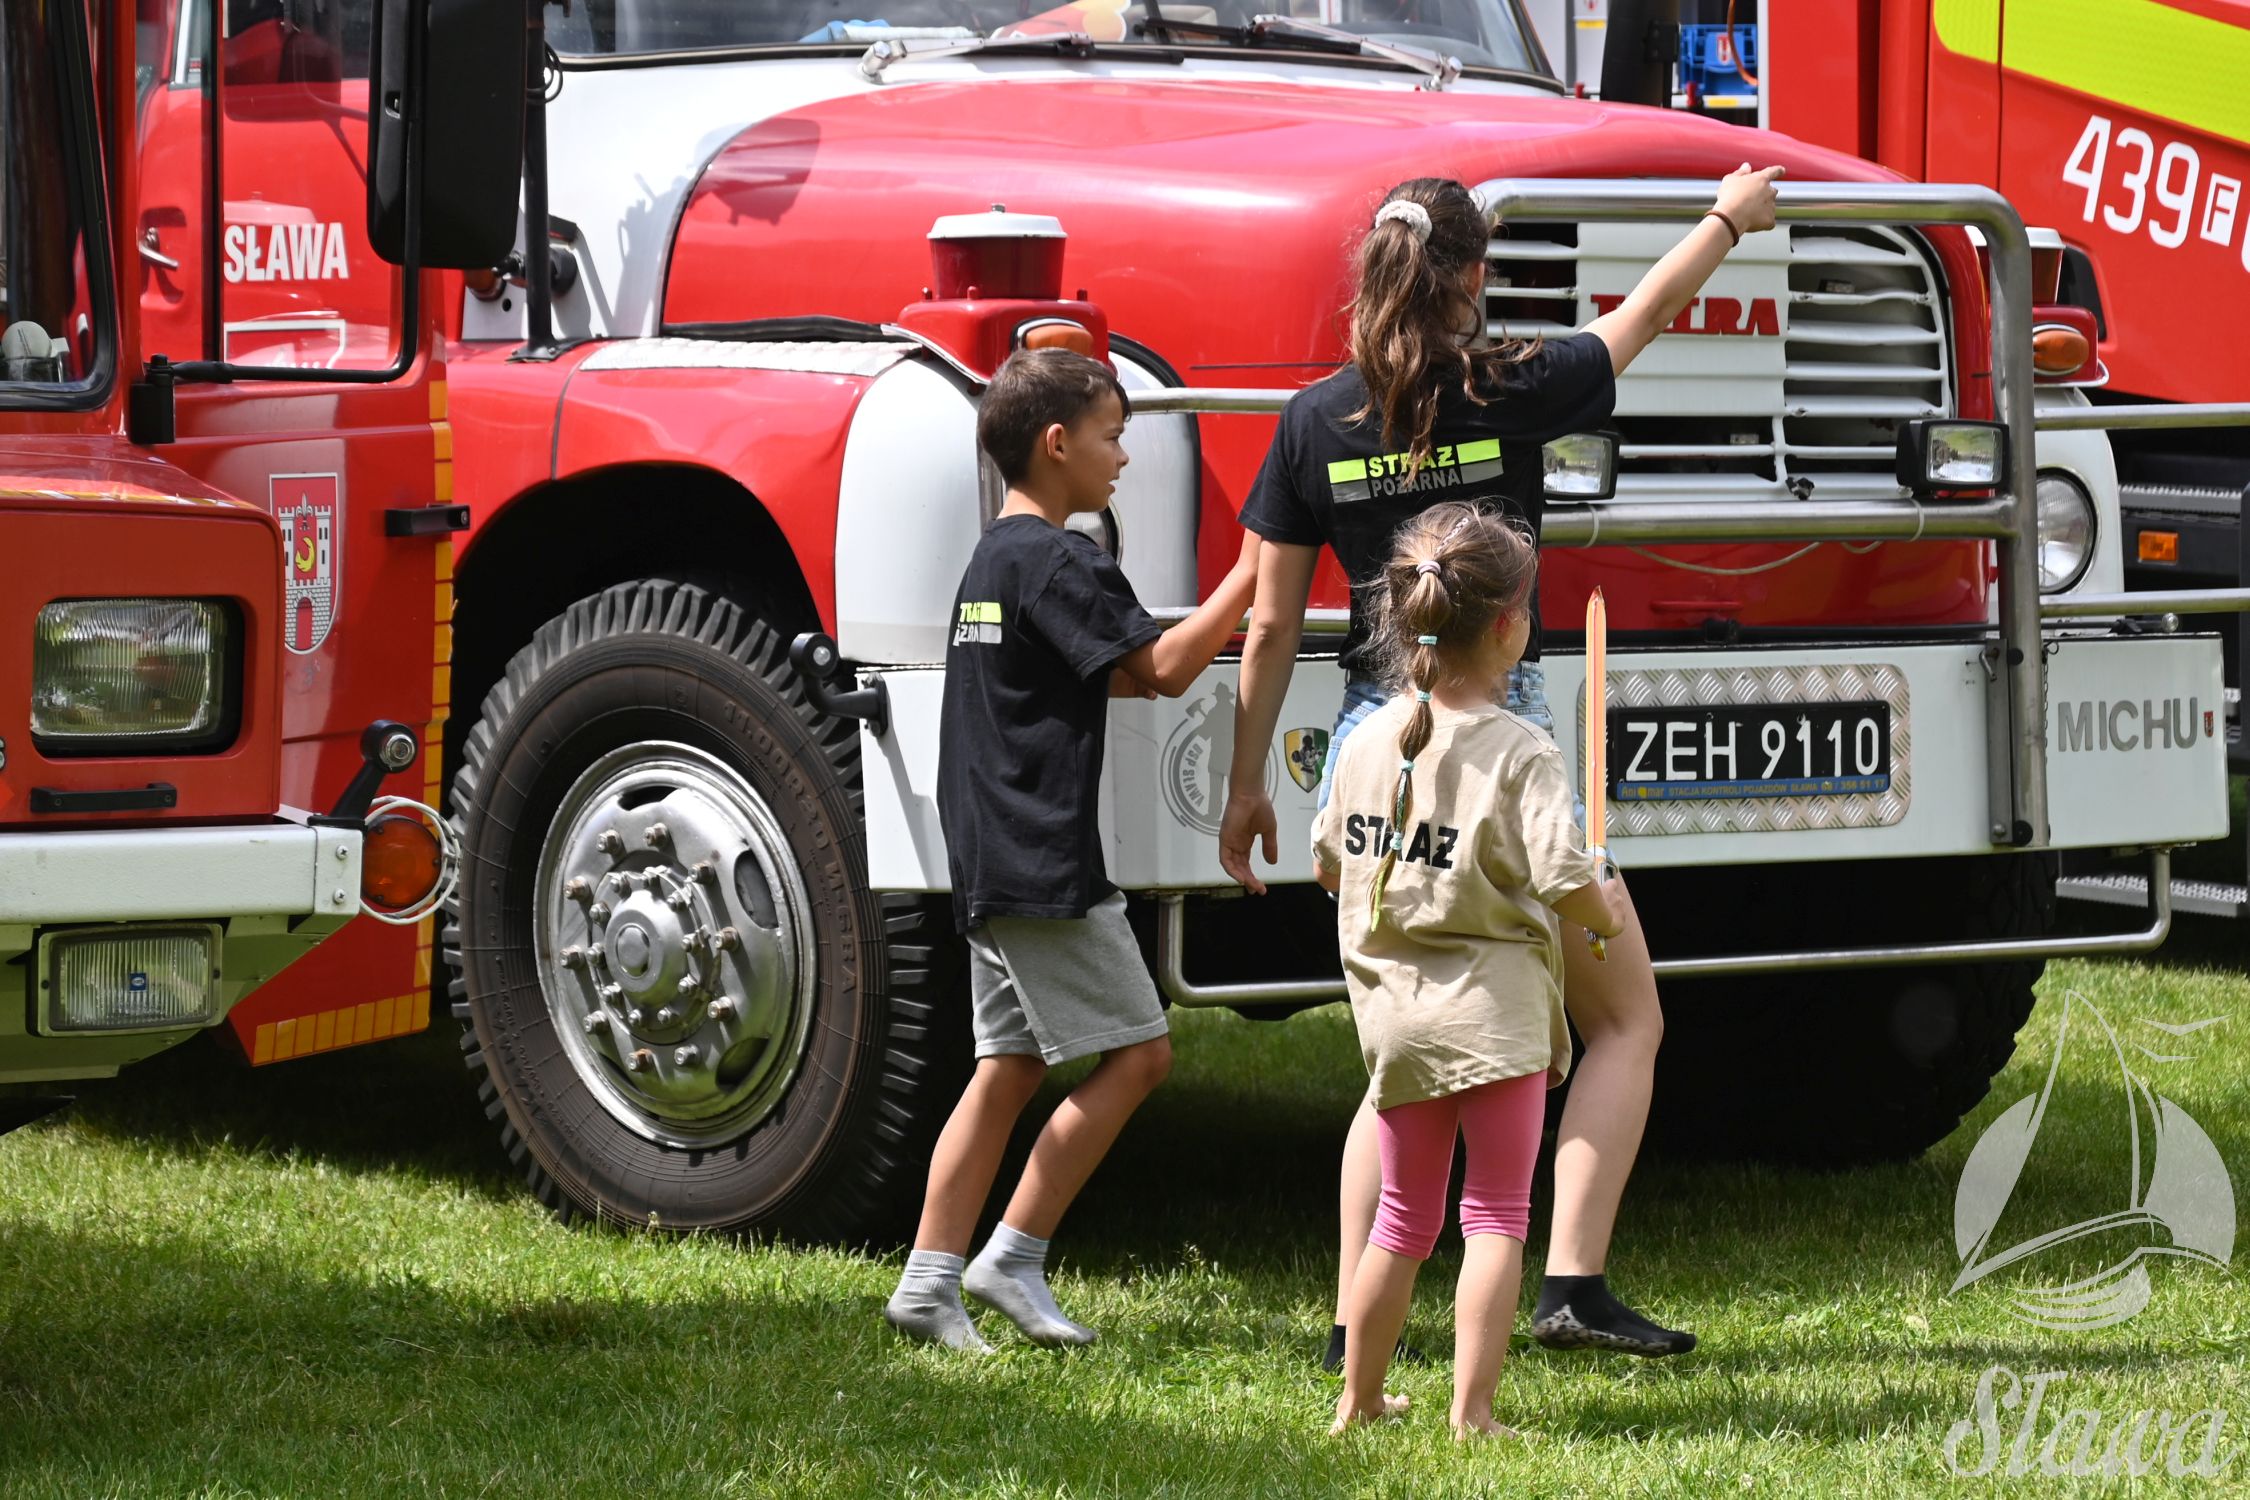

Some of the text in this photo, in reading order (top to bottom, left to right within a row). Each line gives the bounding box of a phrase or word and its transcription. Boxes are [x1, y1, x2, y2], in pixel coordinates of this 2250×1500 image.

[2062, 114, 2200, 249] 439
[223, 222, 349, 283] SŁAWA
[1590, 294, 1780, 336] TTRA
[1625, 717, 1879, 781] ZEH 9110
[2058, 697, 2198, 752] MICHU
